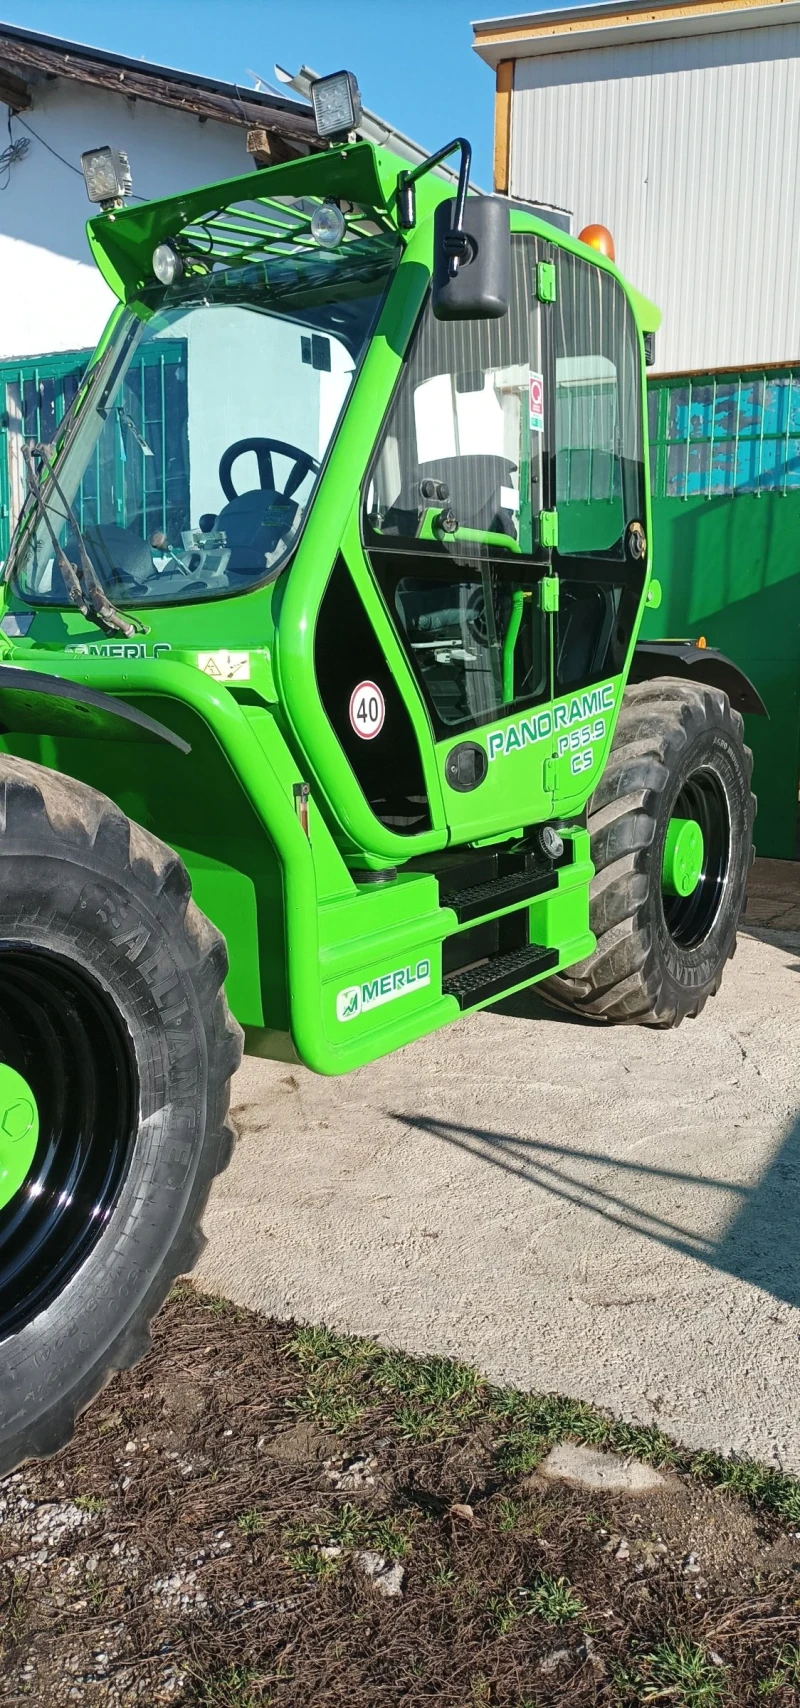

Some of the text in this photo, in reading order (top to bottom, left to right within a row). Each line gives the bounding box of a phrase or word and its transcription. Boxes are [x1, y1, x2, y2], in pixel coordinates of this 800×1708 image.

[356, 697, 378, 723] 40
[488, 685, 614, 759] PANORAMIC
[559, 720, 605, 755] P55.9
[571, 750, 592, 774] CS
[362, 960, 429, 1003] MERLO
[109, 921, 199, 1166] ALLIANCE
